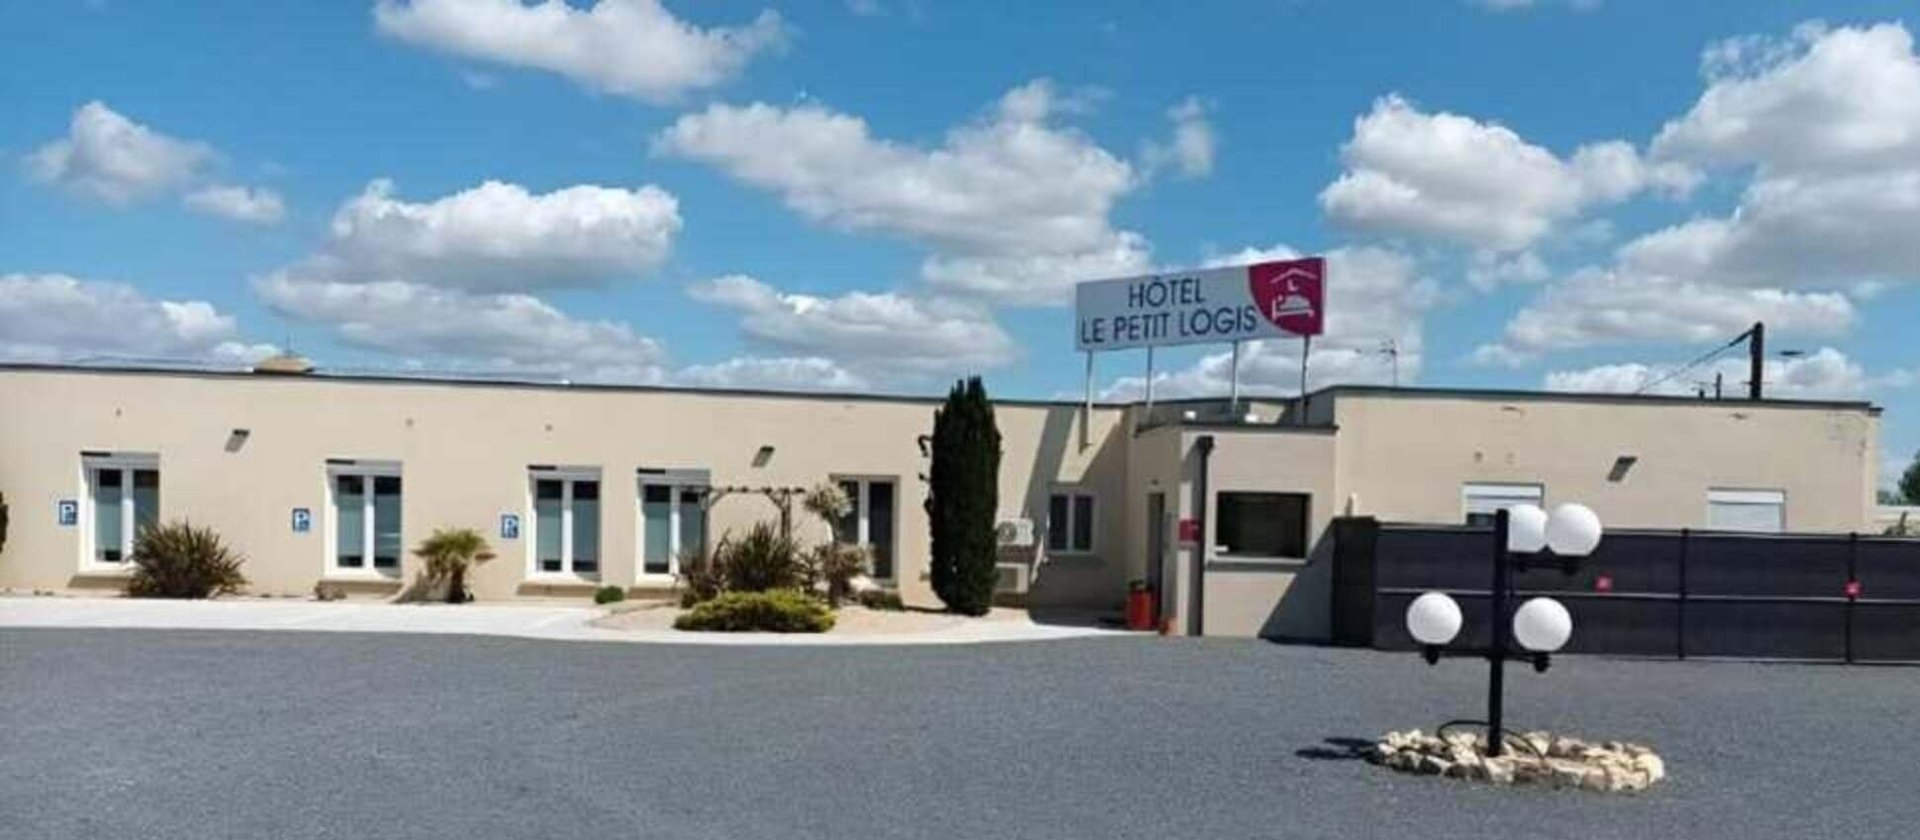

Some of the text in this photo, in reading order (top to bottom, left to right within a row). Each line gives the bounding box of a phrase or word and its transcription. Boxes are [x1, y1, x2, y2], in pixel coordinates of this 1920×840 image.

[1128, 275, 1206, 309] HÔTEL
[1081, 305, 1257, 344] LE PETIT LOGIS
